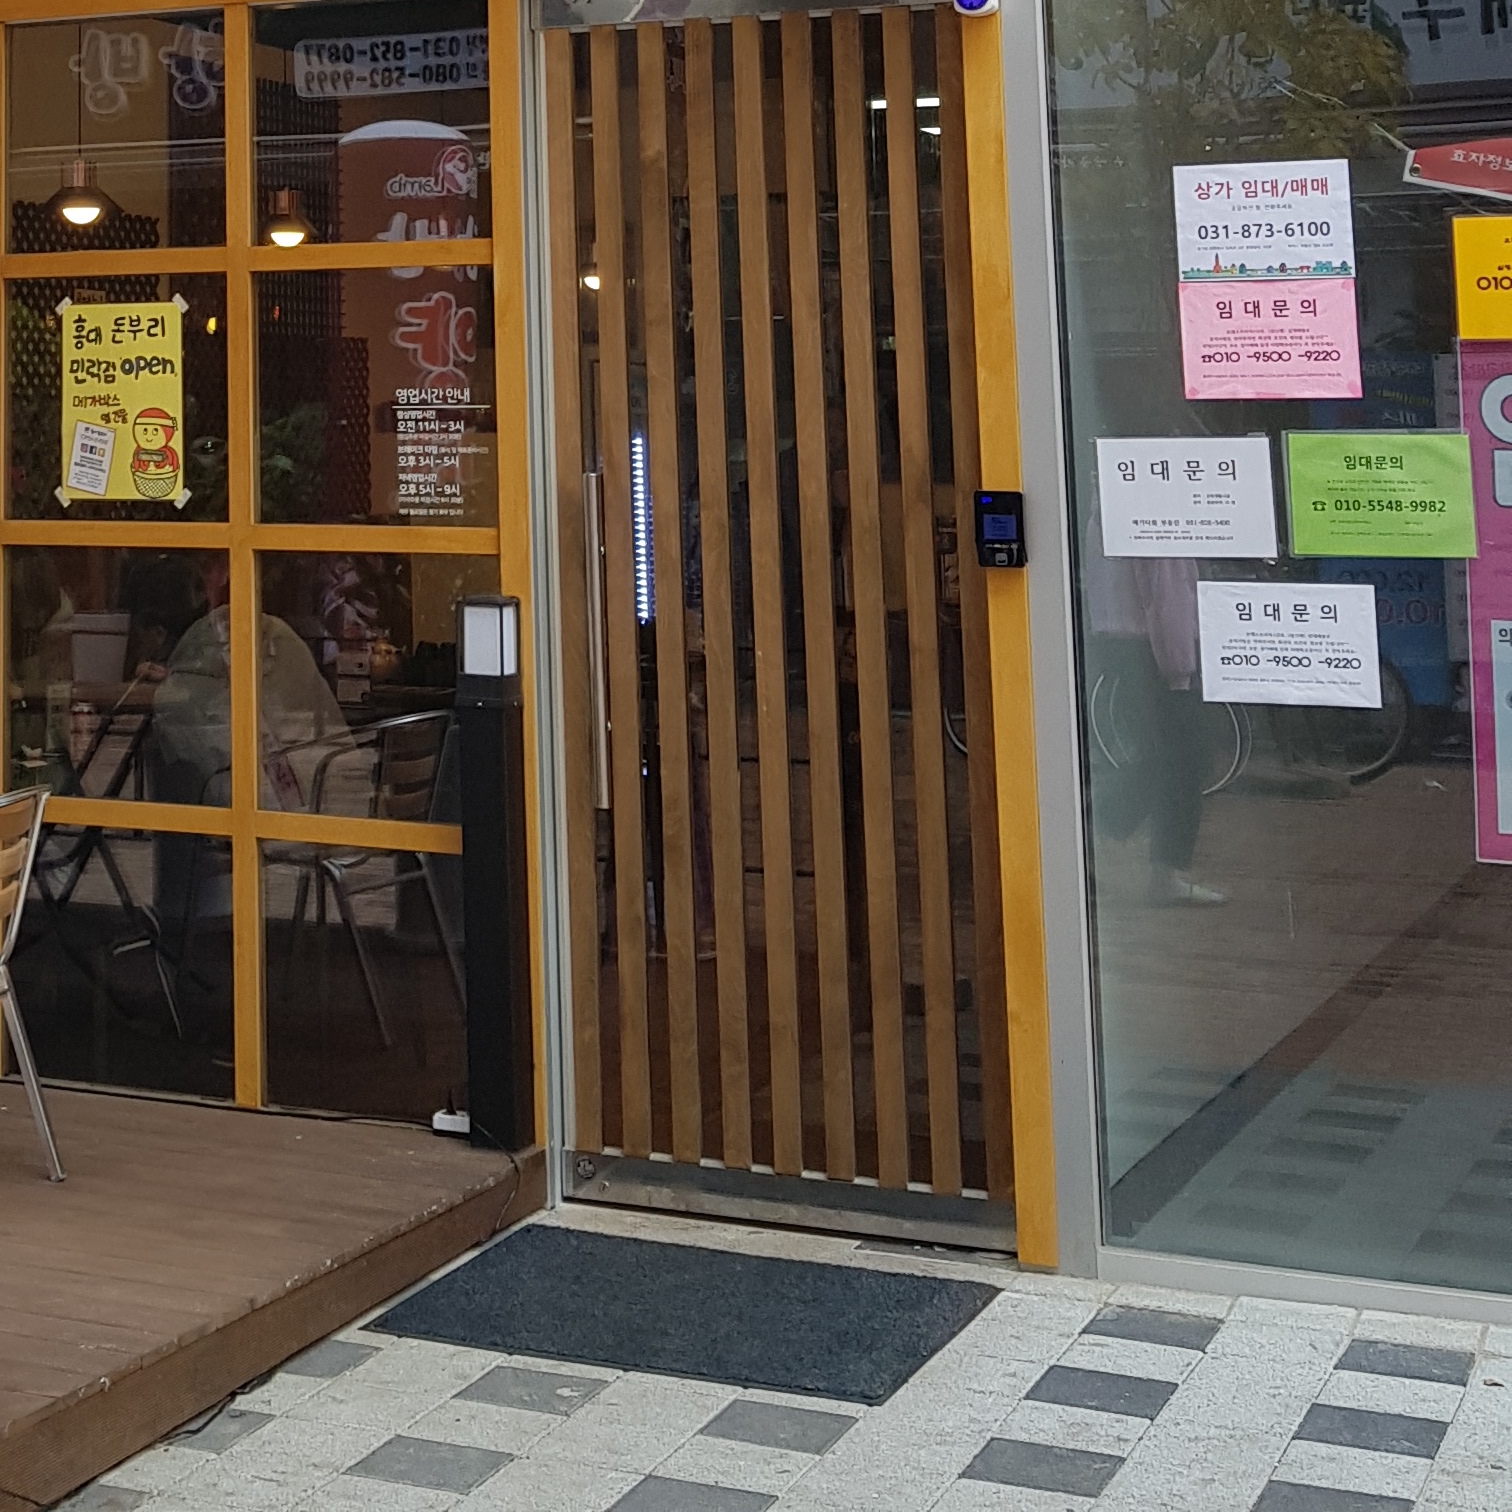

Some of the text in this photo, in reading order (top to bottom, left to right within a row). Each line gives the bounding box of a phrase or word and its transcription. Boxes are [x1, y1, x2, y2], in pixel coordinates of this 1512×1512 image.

[1194, 176, 1330, 200] 상가 임대/매매
[1197, 221, 1332, 240] 031-873-6100
[72, 314, 166, 350] 홍대 돈부리
[69, 357, 117, 385] 민락점
[72, 393, 121, 409] 메가박스
[395, 387, 470, 404] 영업시간 안내
[396, 420, 416, 432] 오전
[398, 455, 417, 467] 오후
[1343, 454, 1404, 471] 임대문의
[399, 483, 418, 495] 오후
[1334, 499, 1447, 514] 010-5548-9982
